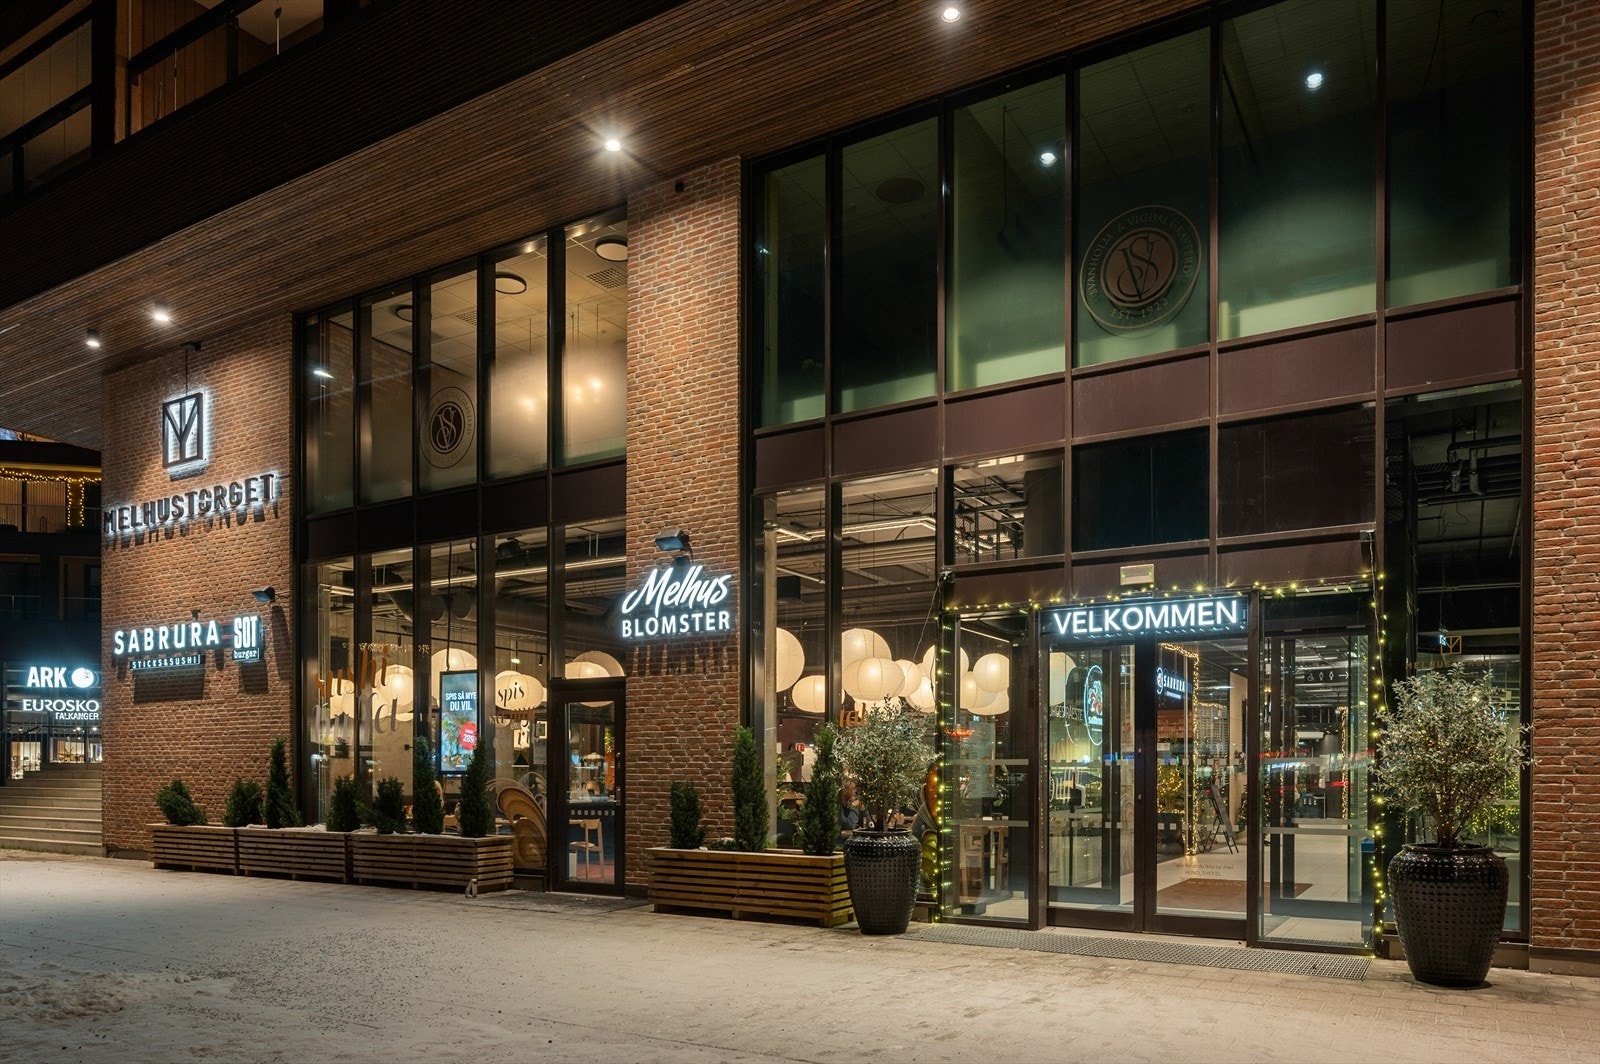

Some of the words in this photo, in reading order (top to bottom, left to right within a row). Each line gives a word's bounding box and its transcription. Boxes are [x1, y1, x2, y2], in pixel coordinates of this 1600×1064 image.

[1087, 233, 1113, 295] SVANHOLM
[103, 473, 276, 533] MELHUSTORGET
[622, 565, 731, 618] Melhus
[622, 611, 730, 637] BLOMSTER
[1053, 600, 1238, 634] VELKOMMEN
[114, 620, 220, 655] SABRURA
[233, 616, 258, 649] SOT
[132, 657, 197, 669] STICKS&SUSHI
[233, 650, 257, 660] burger
[27, 666, 67, 688] ARK
[22, 699, 99, 712] EUROSKO
[445, 692, 457, 701] SPIS
[458, 691, 465, 700] SÅ
[466, 691, 477, 700] MYE
[450, 701, 460, 711] DU
[461, 701, 473, 711] VIL
[497, 681, 525, 708] spis
